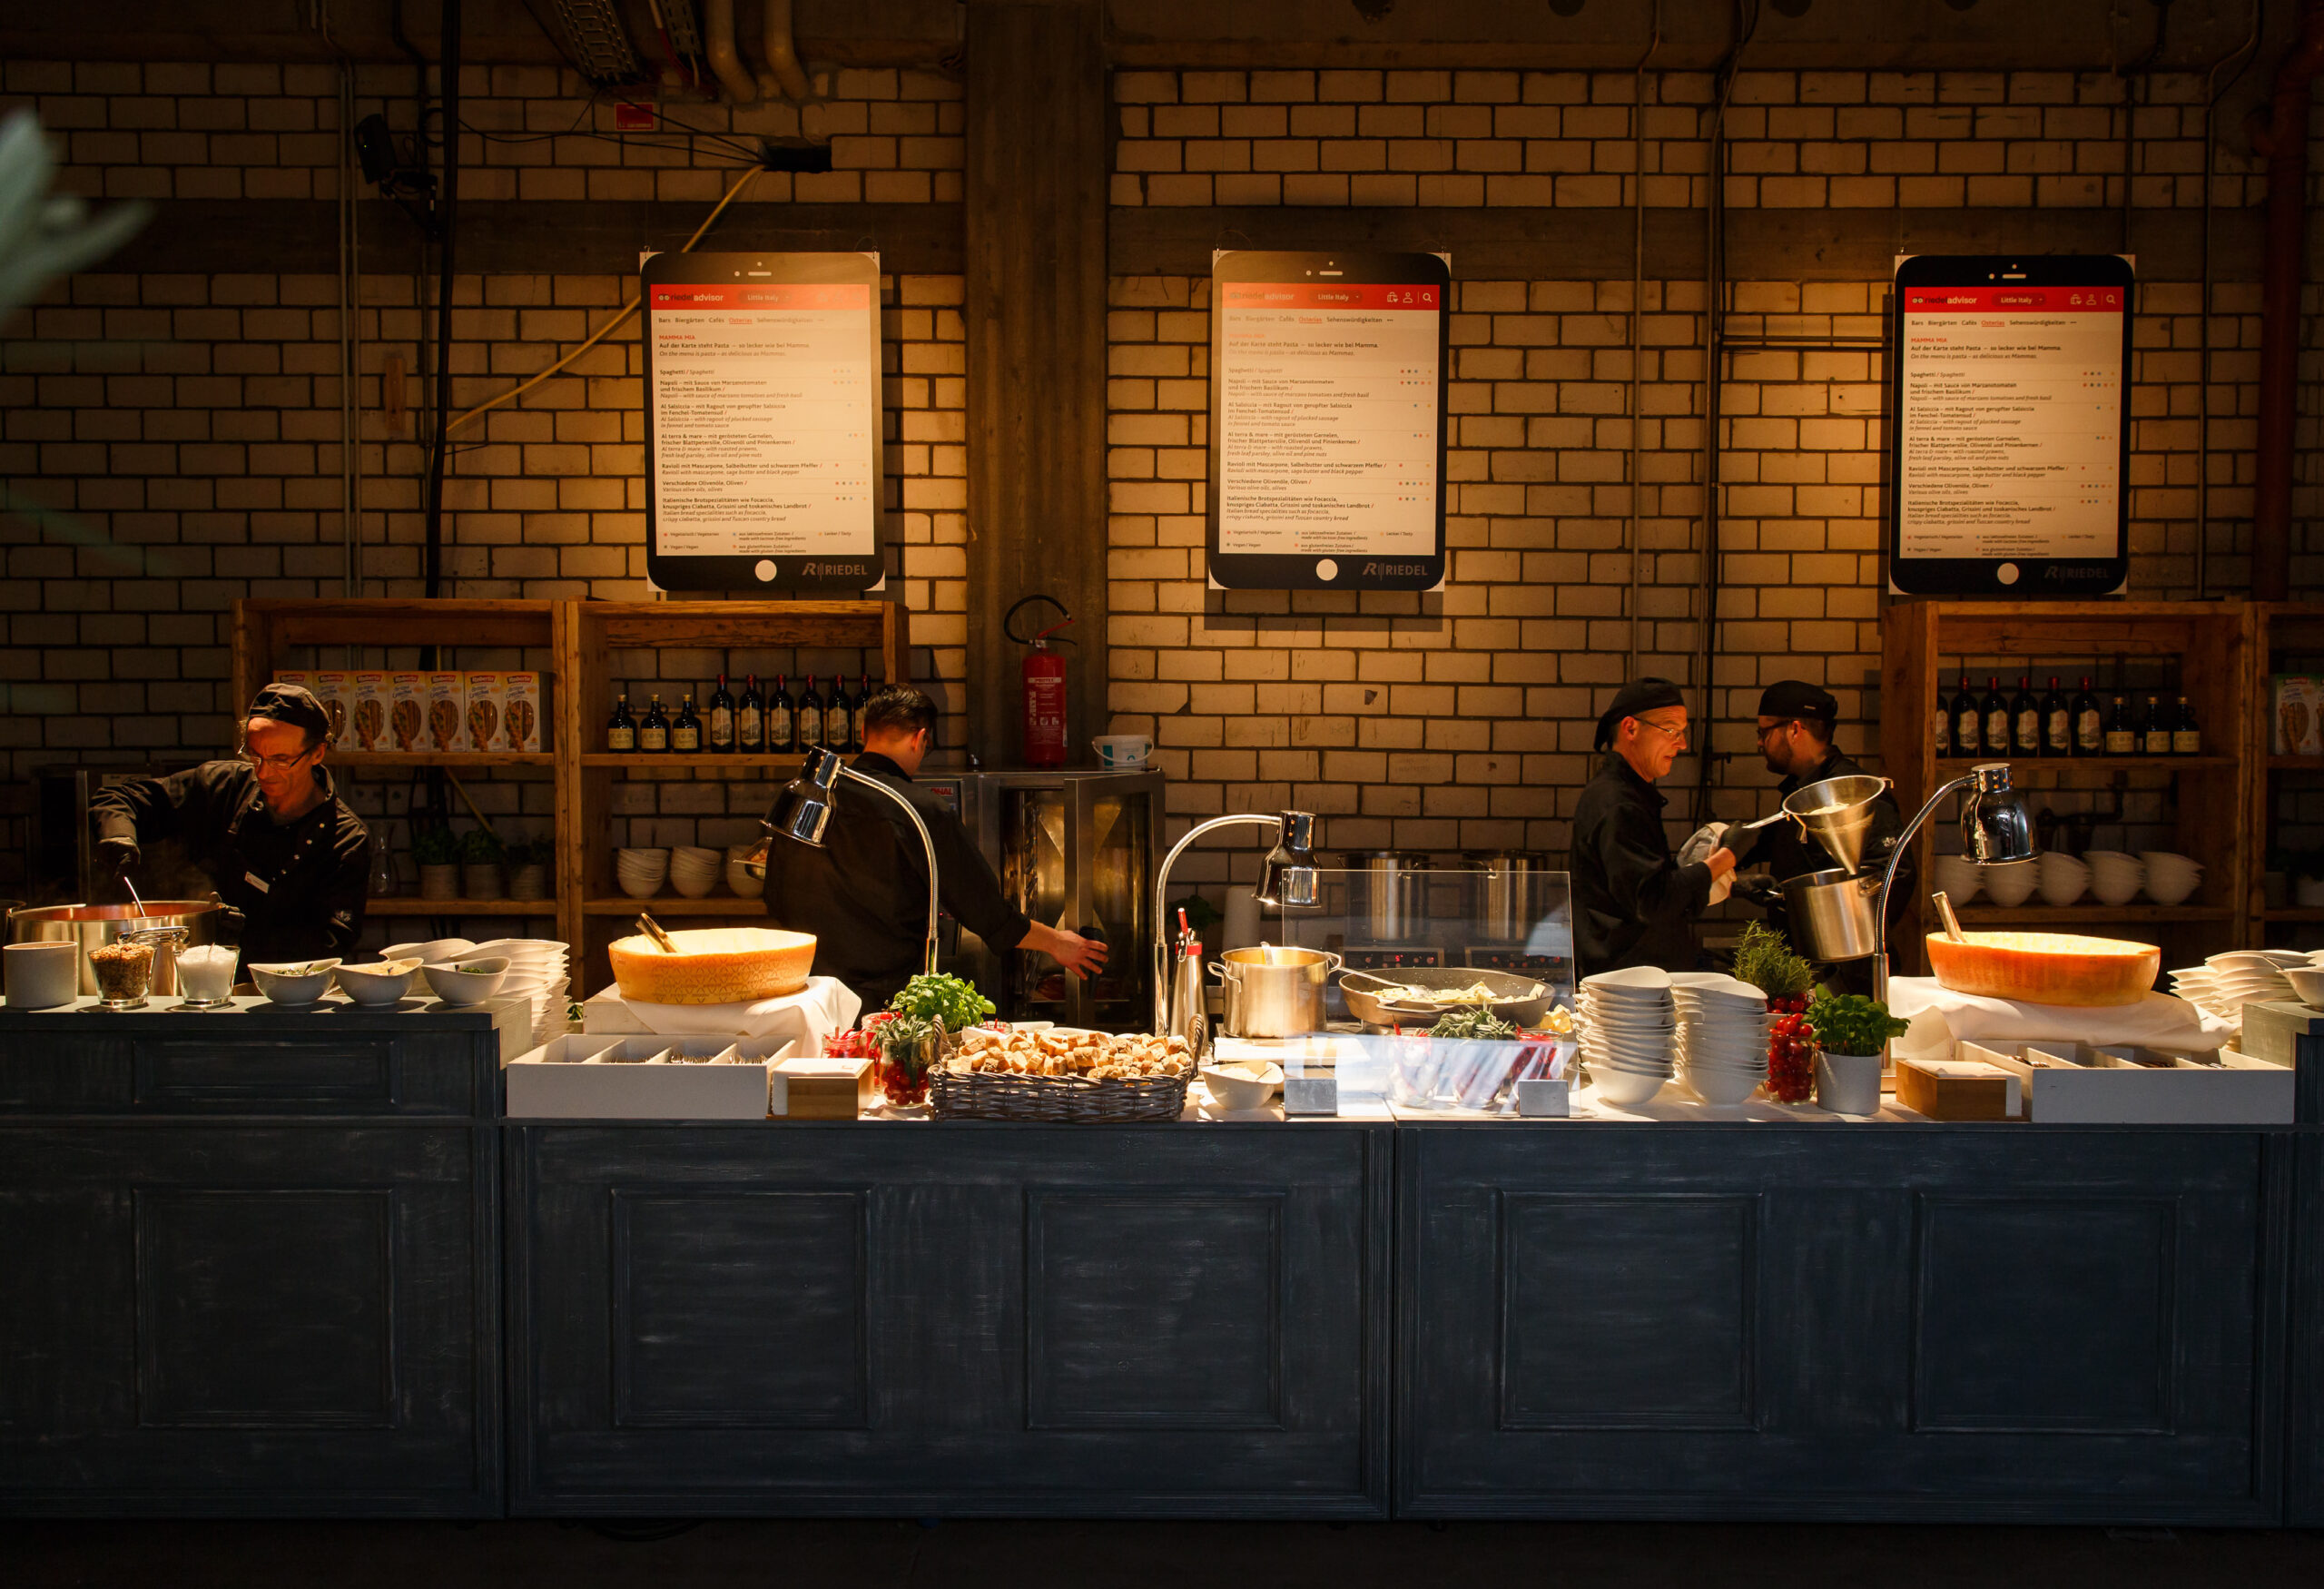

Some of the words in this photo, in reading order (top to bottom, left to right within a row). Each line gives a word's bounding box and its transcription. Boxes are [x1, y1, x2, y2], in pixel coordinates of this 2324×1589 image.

[764, 293, 779, 302] Italy
[1334, 293, 1349, 301] Italy
[2018, 296, 2033, 305] Italy
[825, 564, 868, 576] RIEDEL
[1386, 563, 1428, 576] RIEDEL
[2066, 567, 2109, 578] RIEDEL
